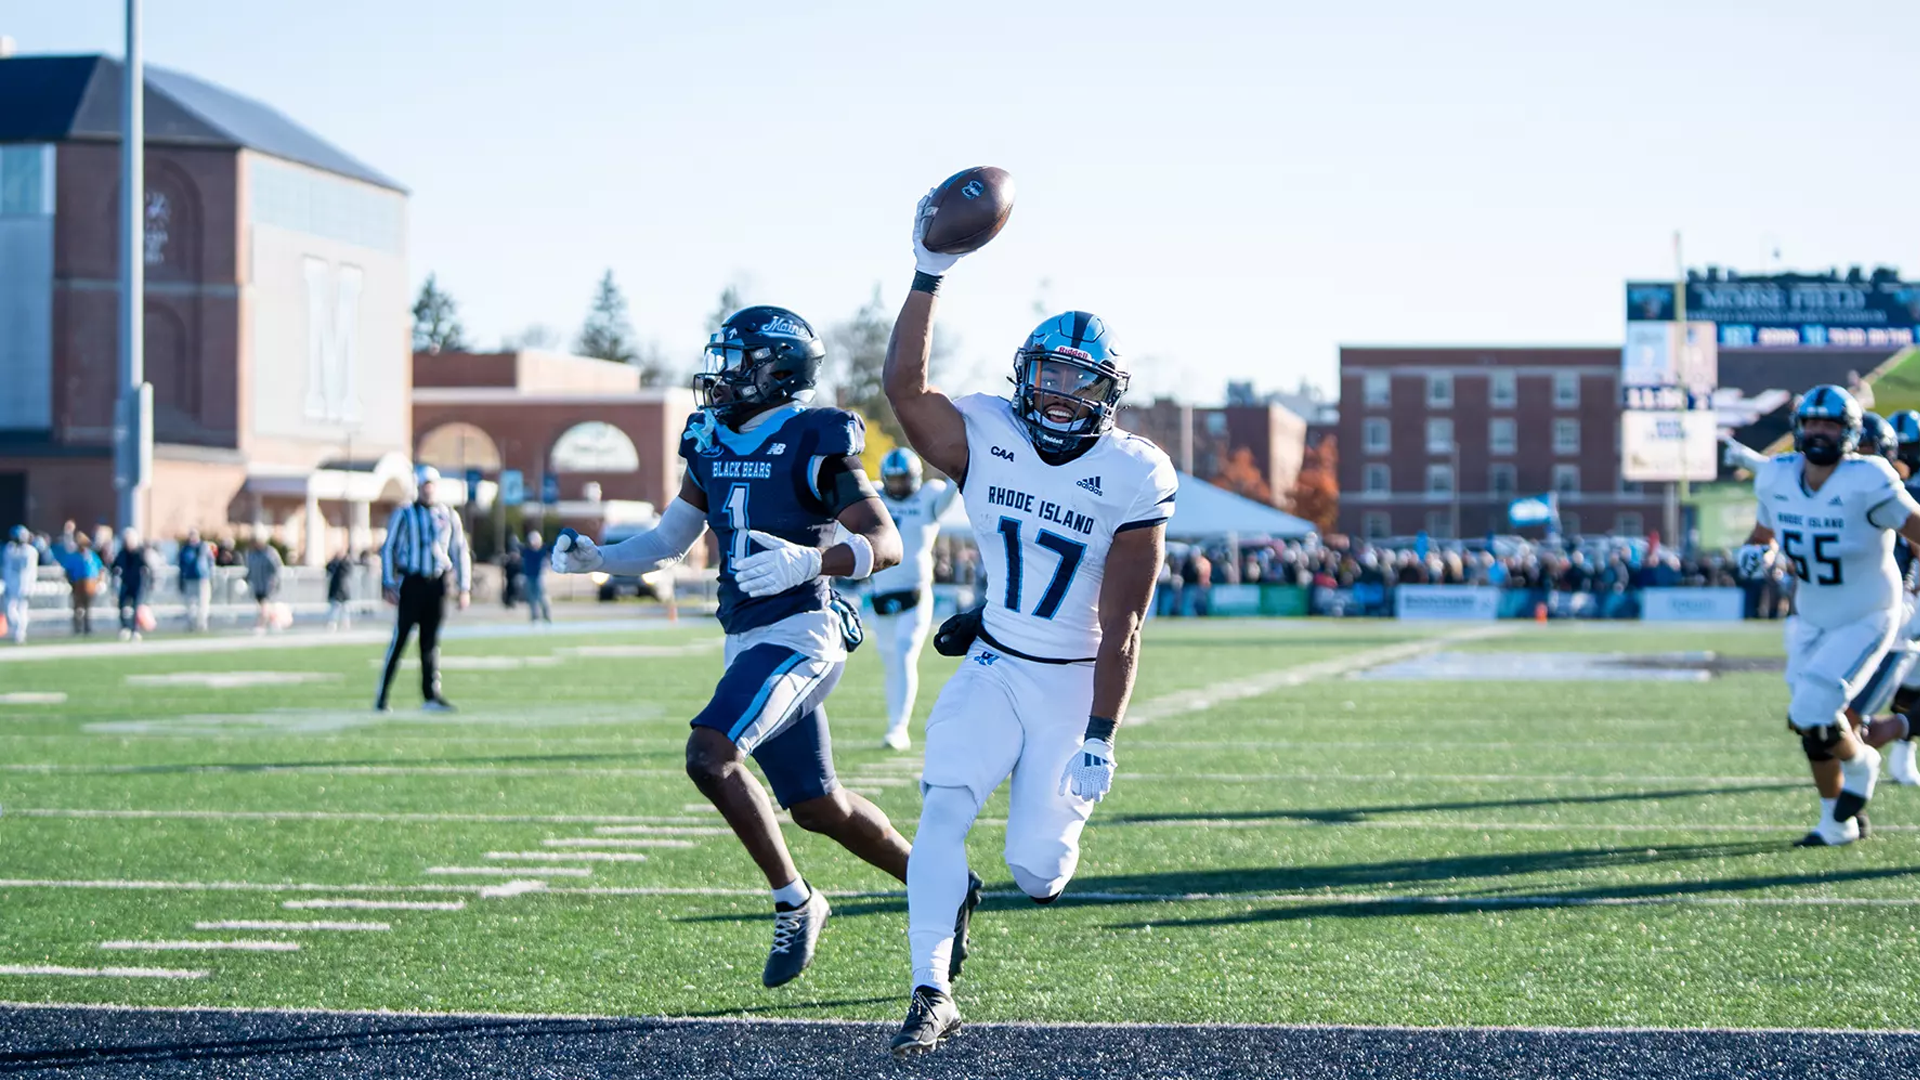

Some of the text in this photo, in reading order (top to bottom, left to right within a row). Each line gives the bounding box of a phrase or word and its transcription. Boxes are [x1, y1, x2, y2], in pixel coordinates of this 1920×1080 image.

[761, 315, 807, 337] Maine
[1058, 346, 1089, 360] Riddell
[990, 445, 1015, 462] CAA
[712, 461, 772, 479] BLACK BEARS
[1076, 480, 1103, 497] adidas
[988, 486, 1095, 535] RHODE ISLAND
[722, 482, 751, 575] 1
[1808, 516, 1845, 529] ISLAND
[997, 515, 1088, 621] 17
